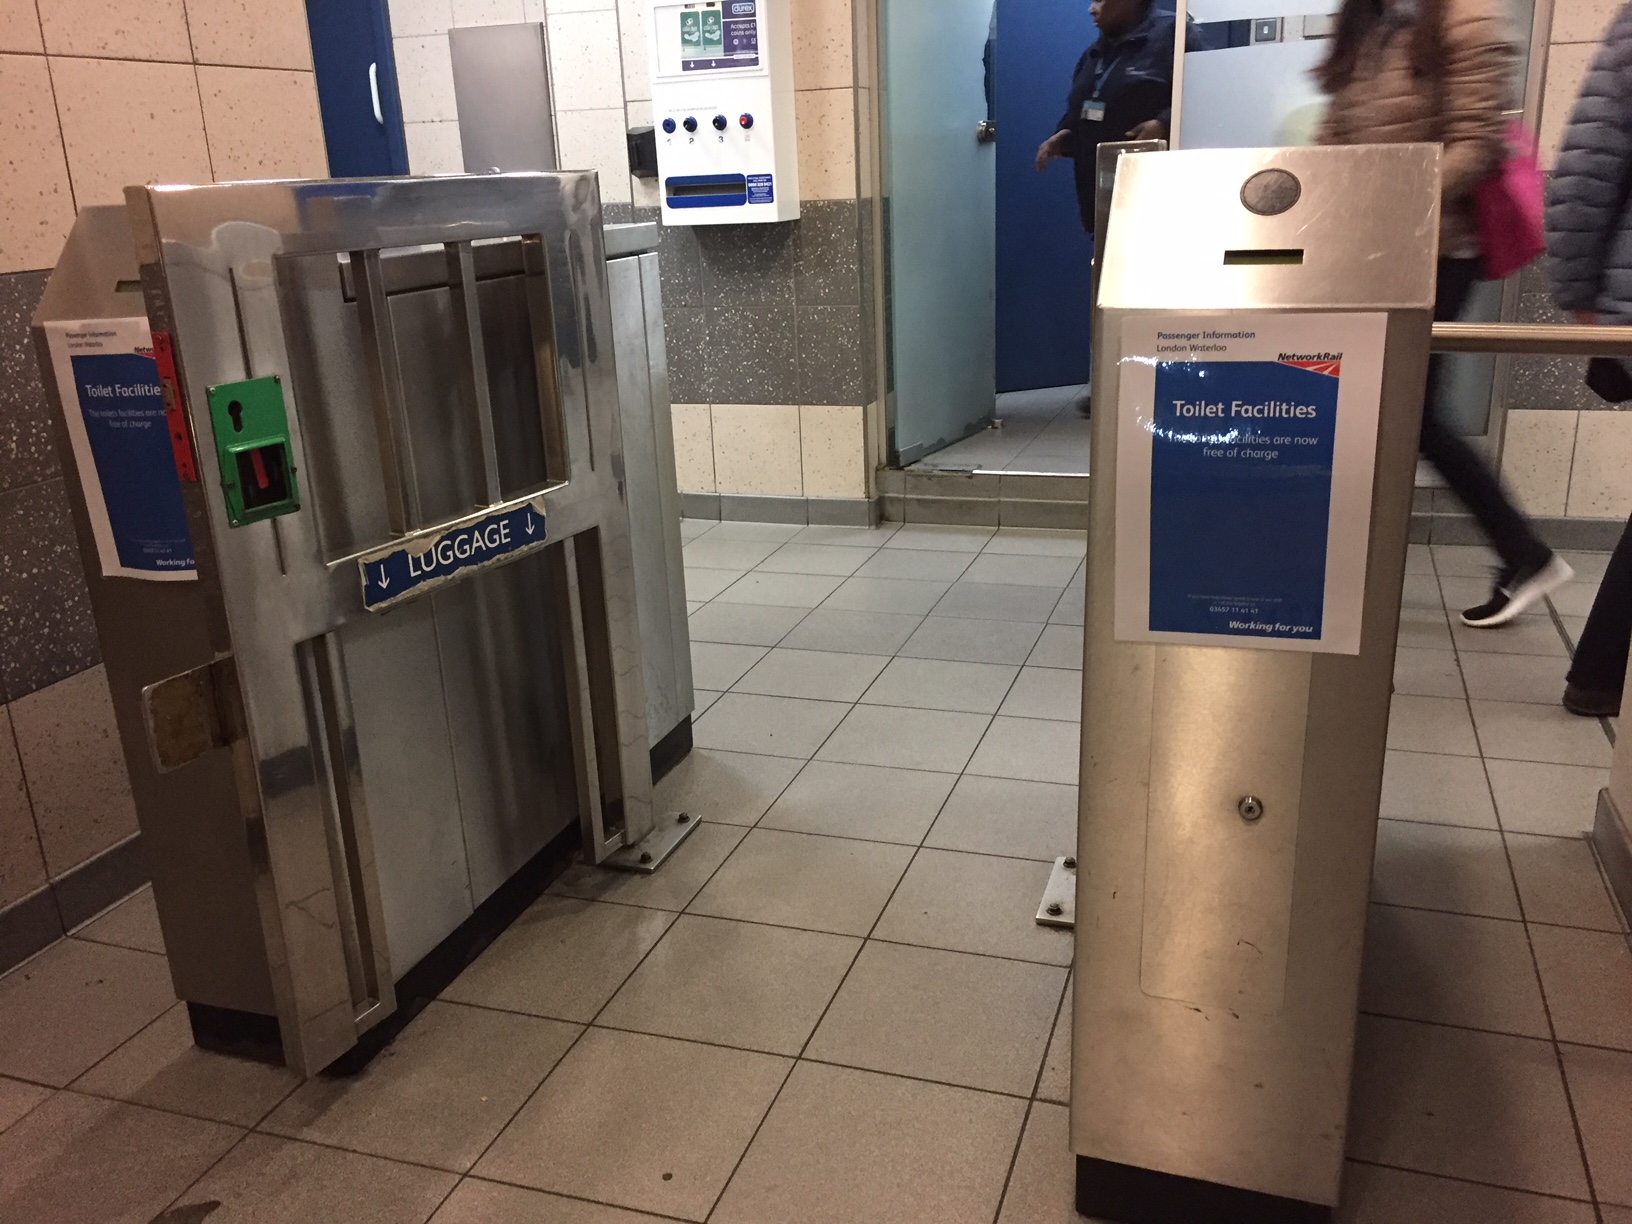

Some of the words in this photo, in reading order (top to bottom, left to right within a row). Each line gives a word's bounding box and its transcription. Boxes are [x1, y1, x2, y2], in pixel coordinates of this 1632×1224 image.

[733, 4, 753, 13] durex
[718, 135, 724, 143] 3
[1157, 331, 1200, 341] Passenger
[1203, 330, 1255, 339] Information
[1156, 344, 1187, 353] London
[1189, 343, 1227, 352] Waterloo
[1277, 352, 1344, 361] NetworkRail
[85, 384, 114, 397] Toilet
[115, 383, 162, 397] Facilitie
[1172, 400, 1225, 417] Toilet
[1231, 400, 1317, 418] Facilities
[129, 420, 152, 430] charge
[1226, 432, 1271, 445] acilities
[1273, 436, 1291, 445] are
[1294, 436, 1319, 445] now
[1203, 447, 1224, 458] free
[1227, 446, 1239, 457] of
[1241, 448, 1279, 460] charge
[407, 519, 511, 578] LUGGAGE
[156, 558, 186, 567] Working
[186, 557, 196, 565] fo
[1229, 620, 1273, 632] Working
[1274, 622, 1291, 632] for
[1292, 624, 1314, 634] you
